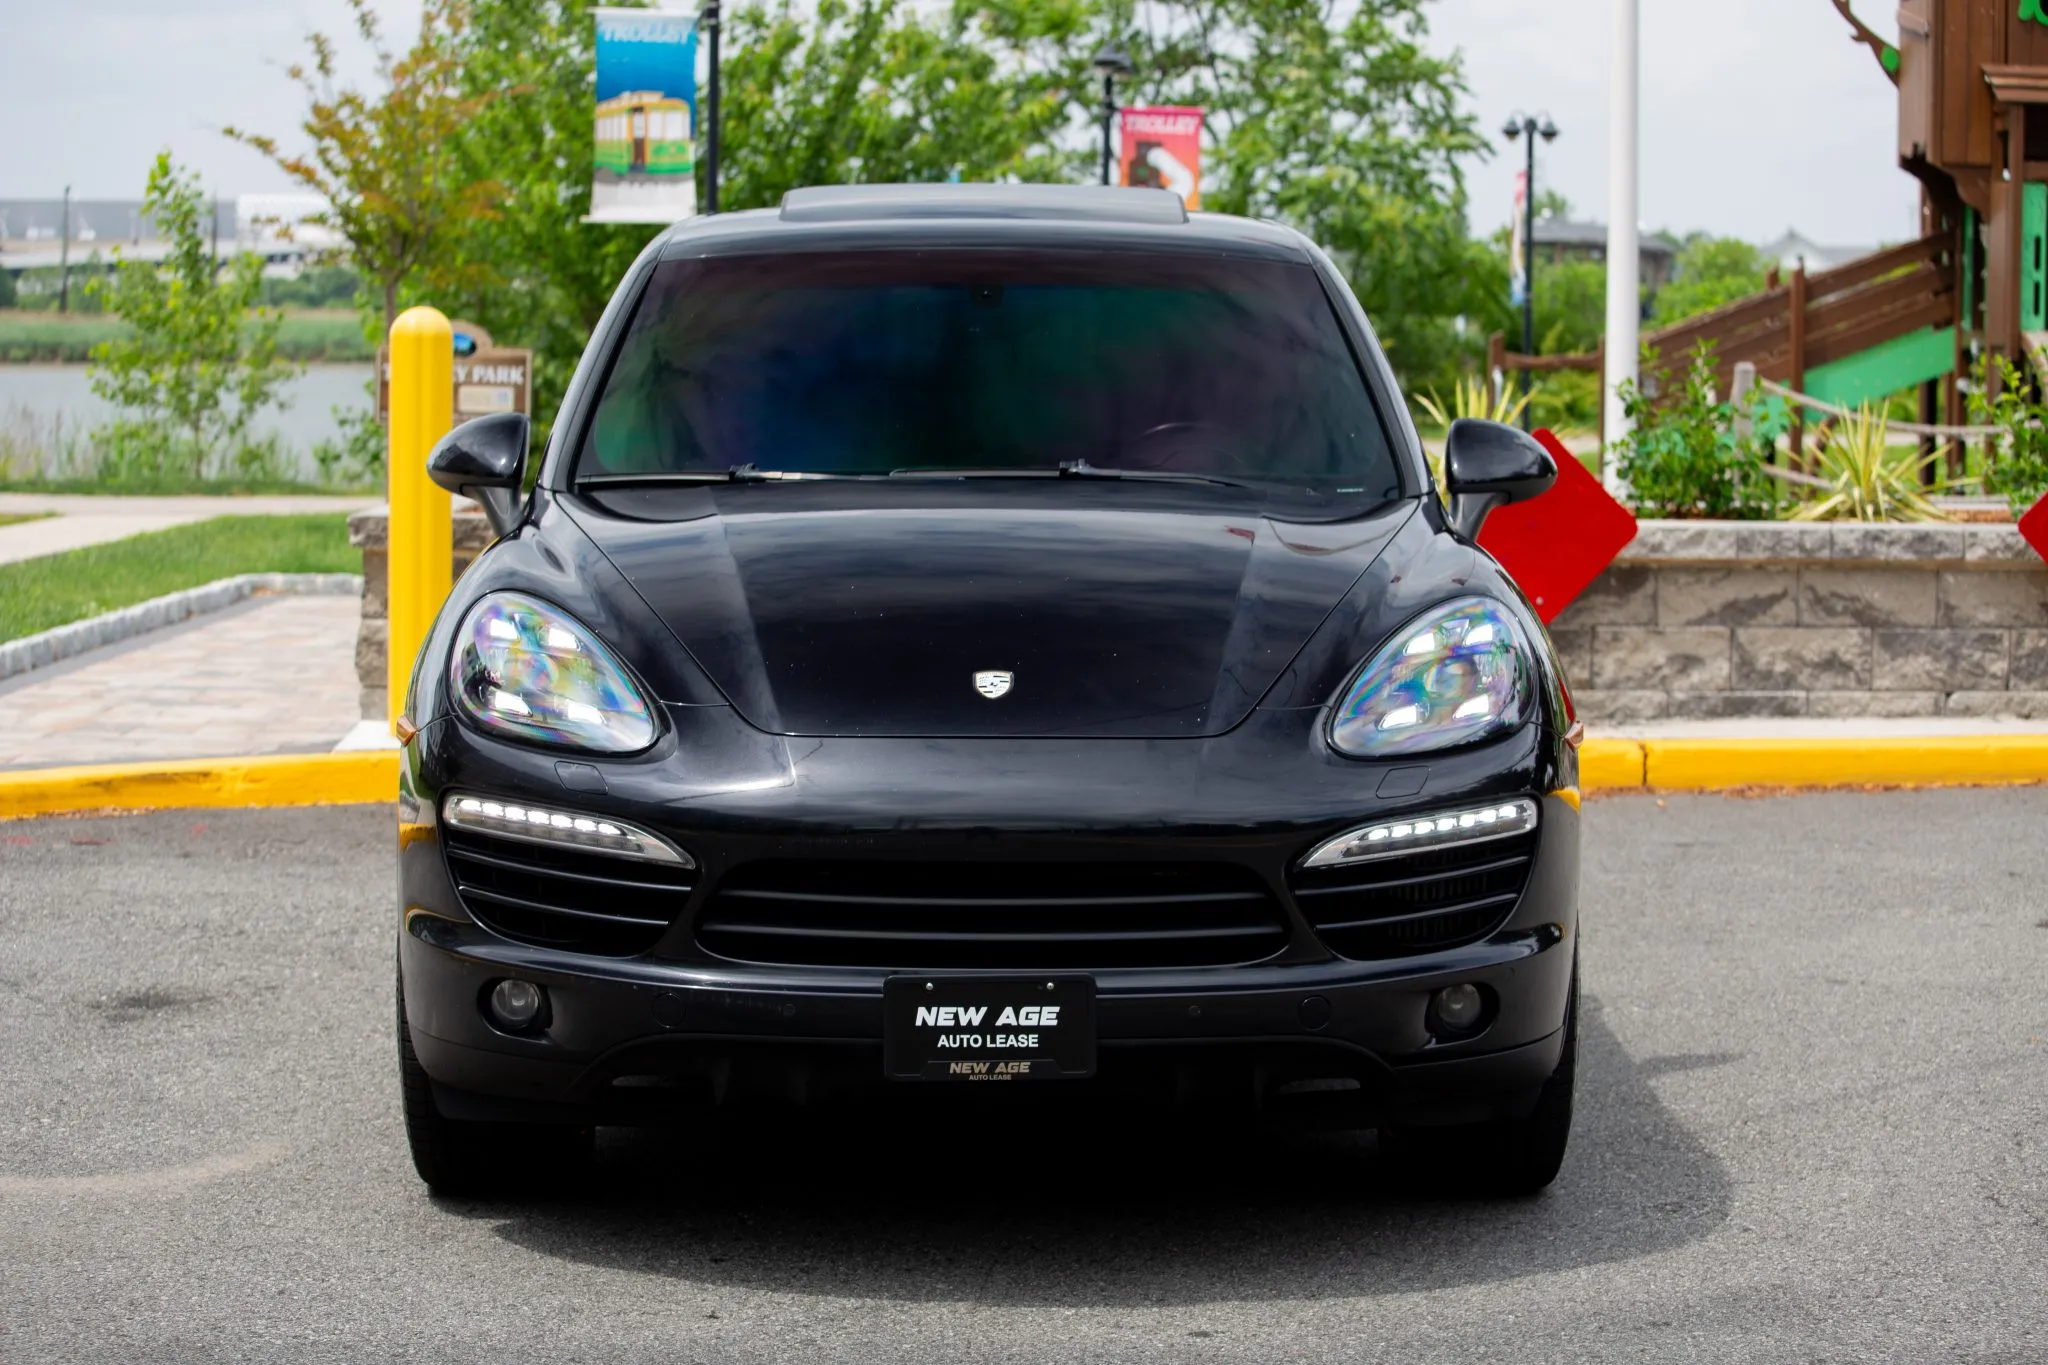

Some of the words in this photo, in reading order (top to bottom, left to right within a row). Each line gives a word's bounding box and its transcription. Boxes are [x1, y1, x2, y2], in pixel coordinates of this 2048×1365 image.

[1125, 114, 1200, 135] TROLLEY
[472, 364, 525, 385] PARK
[915, 1006, 988, 1027] NEW
[995, 1006, 1060, 1026] AGE
[937, 1034, 982, 1048] AUTO
[986, 1034, 1039, 1047] LEASE
[949, 1062, 990, 1074] NEW
[994, 1062, 1031, 1073] AGE
